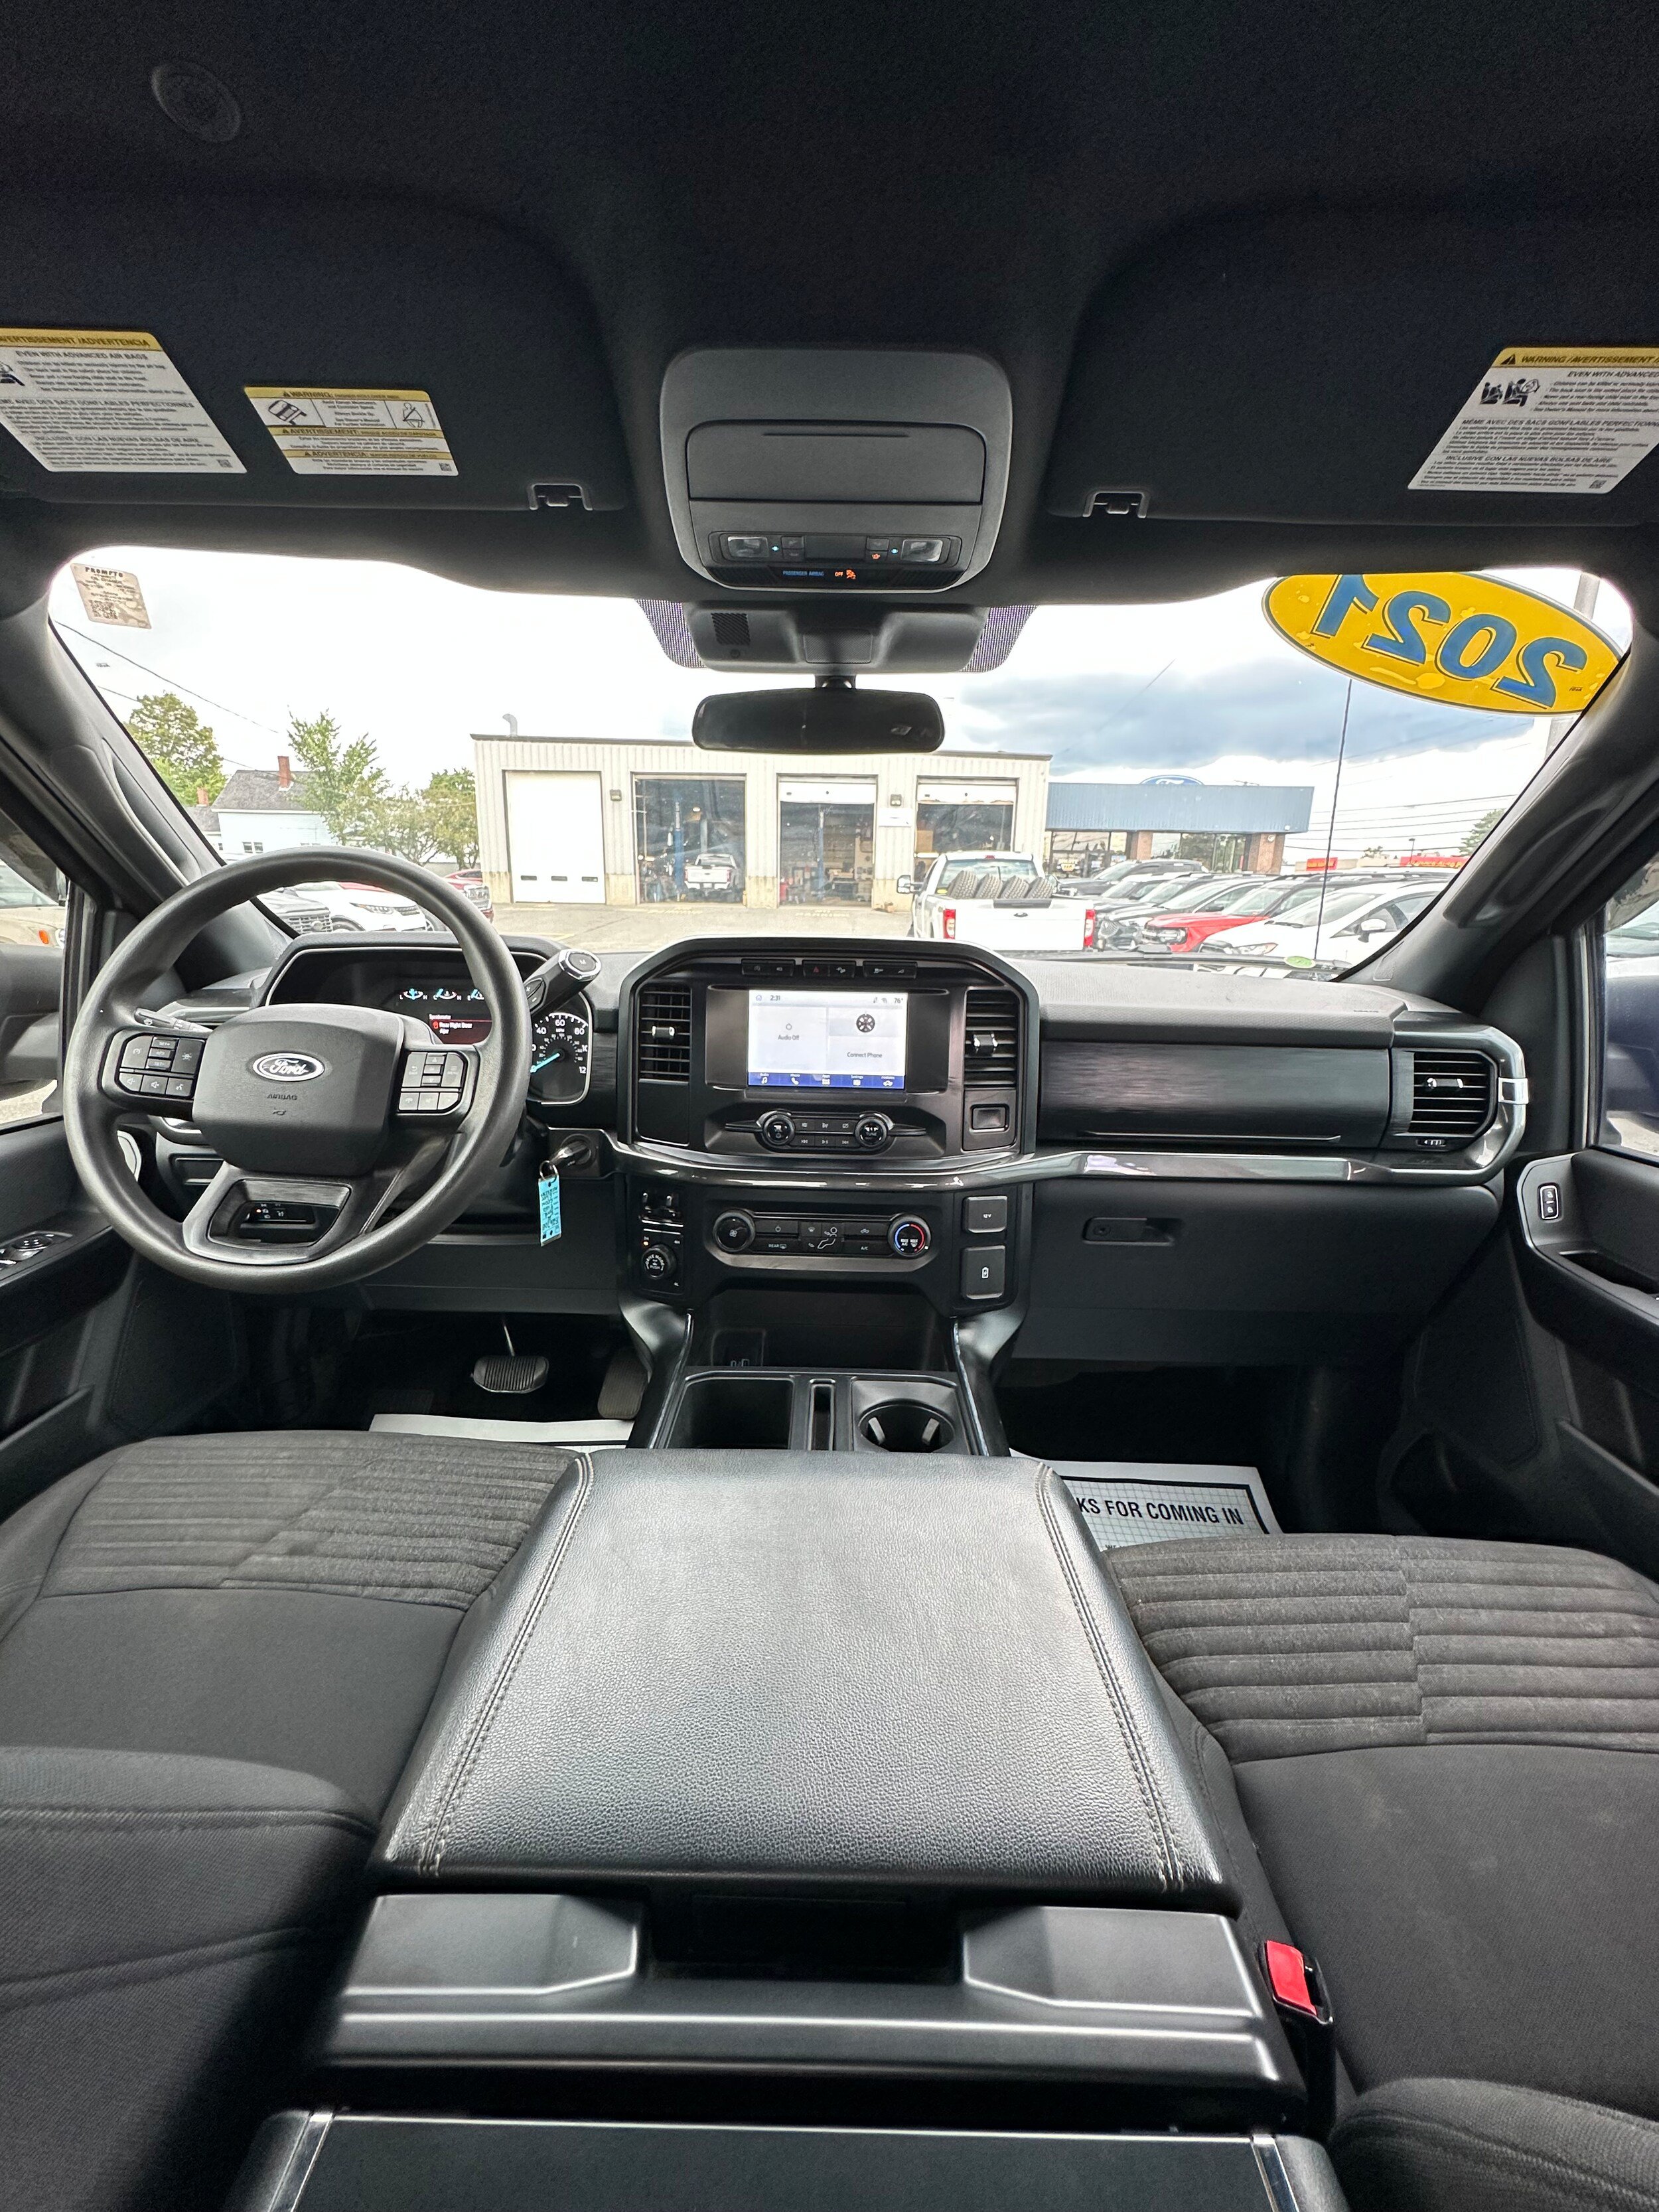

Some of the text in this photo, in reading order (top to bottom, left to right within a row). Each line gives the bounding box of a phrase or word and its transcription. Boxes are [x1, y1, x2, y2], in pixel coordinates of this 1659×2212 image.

[269, 1058, 309, 1075] Ford
[1076, 1497, 1245, 1525] KS FOR COMING IN
